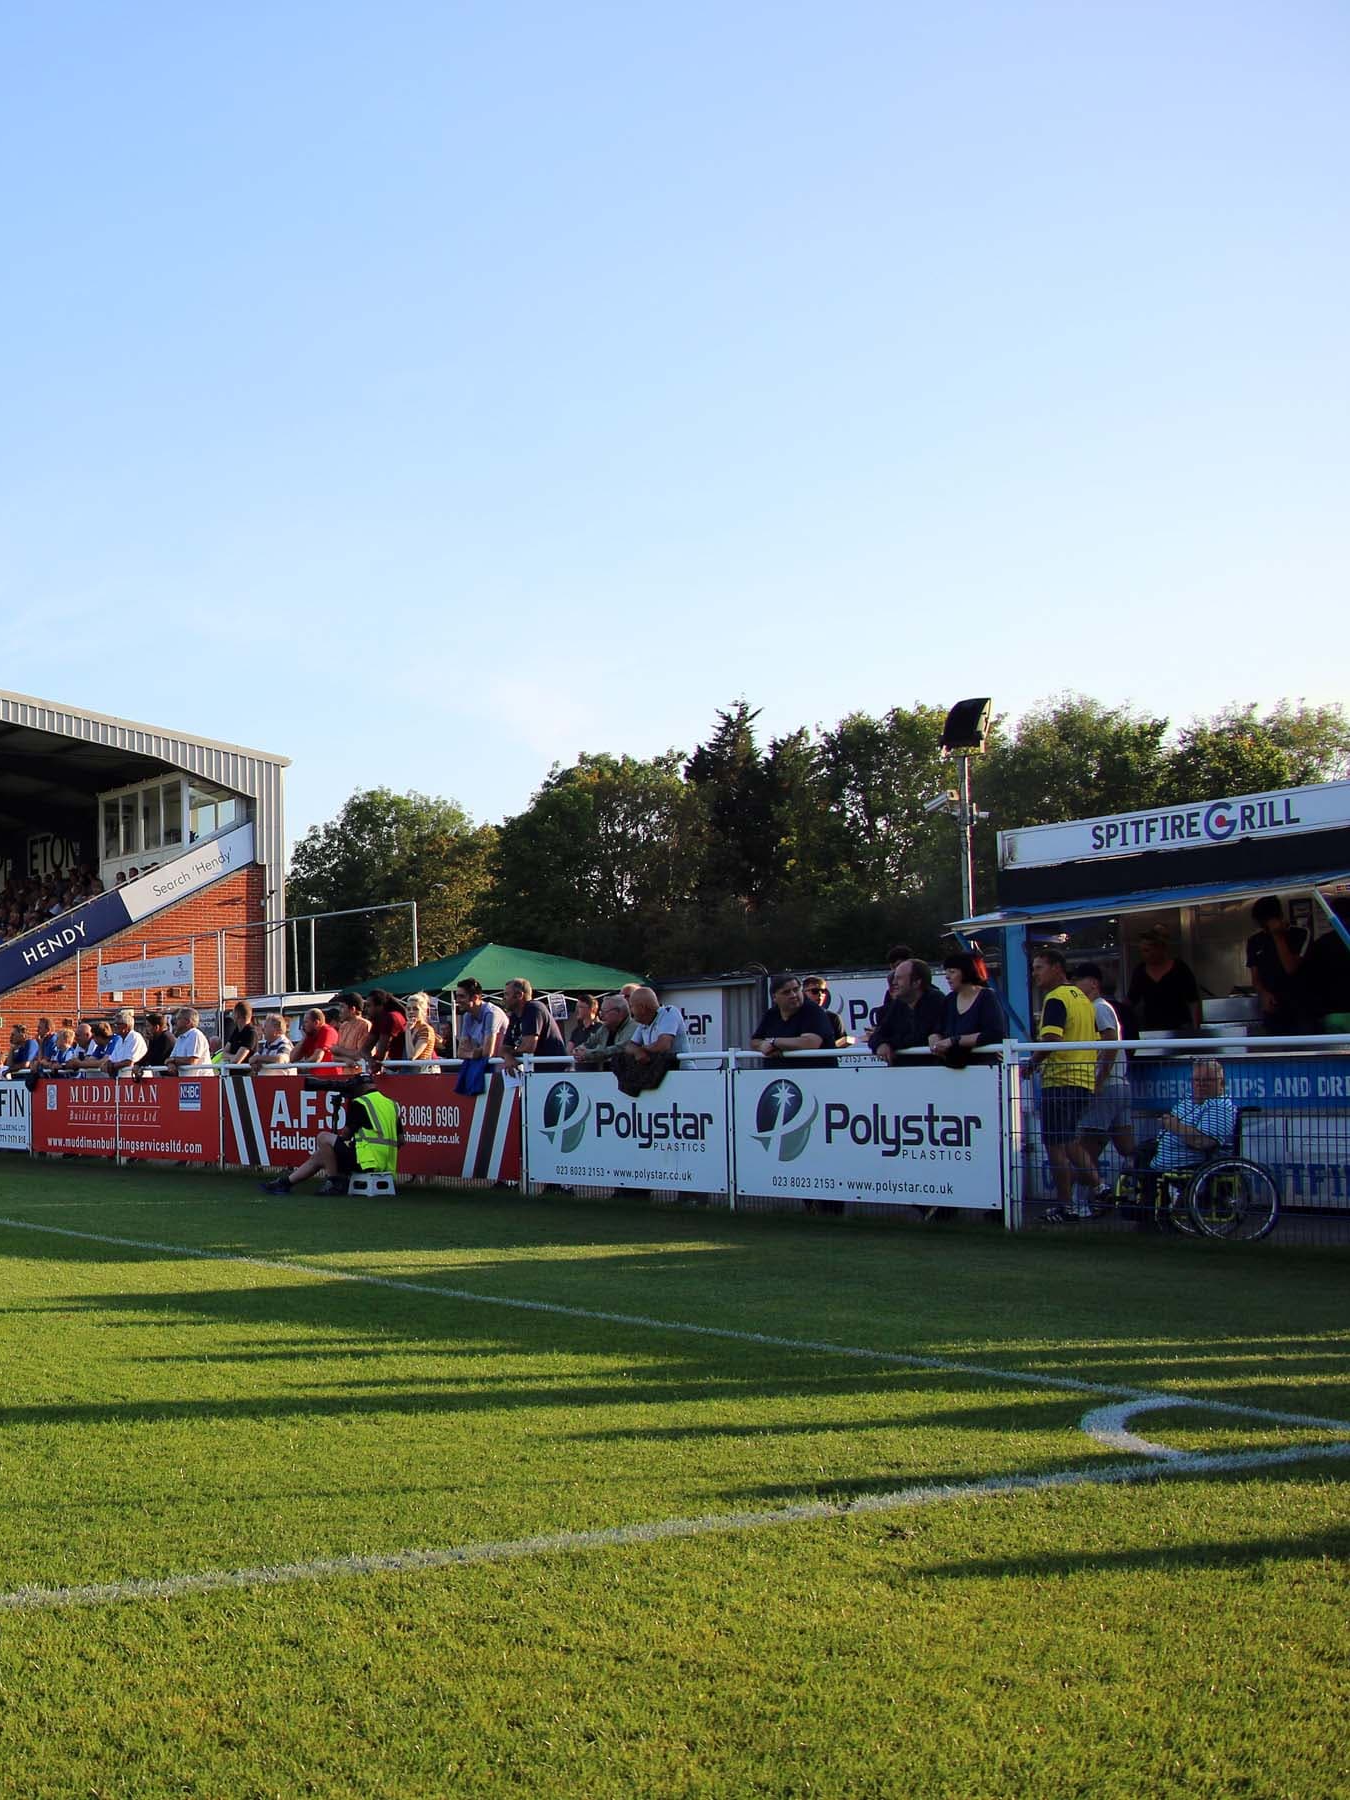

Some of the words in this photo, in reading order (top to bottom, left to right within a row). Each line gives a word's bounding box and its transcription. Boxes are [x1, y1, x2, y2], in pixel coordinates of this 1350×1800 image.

[1091, 811, 1200, 850] SPITFIRE
[1204, 798, 1300, 841] GRILL
[152, 870, 191, 898] Search
[22, 920, 88, 966] HENDY
[1273, 1076, 1309, 1098] AND
[69, 1110, 101, 1123] Building
[143, 1111, 157, 1122] Ltd
[409, 1105, 433, 1127] 8069
[435, 1105, 460, 1128] 6960
[595, 1102, 713, 1149] Polystar
[825, 1103, 982, 1157] Polystar
[47, 1136, 203, 1154] www.muddimanbuildingservicesltd.com
[270, 1130, 316, 1153] Haulag
[653, 1142, 706, 1152] PLASTICS
[902, 1150, 972, 1161] PLASTICS
[555, 1165, 568, 1175] 023
[570, 1165, 586, 1176] 8023
[588, 1166, 605, 1177] 2153
[613, 1168, 692, 1181] www.polystar.co.uk
[772, 1176, 788, 1187] 023
[790, 1176, 812, 1188] 8023
[814, 1177, 835, 1189] 2153
[847, 1180, 954, 1195] www.polystar.co.uk
